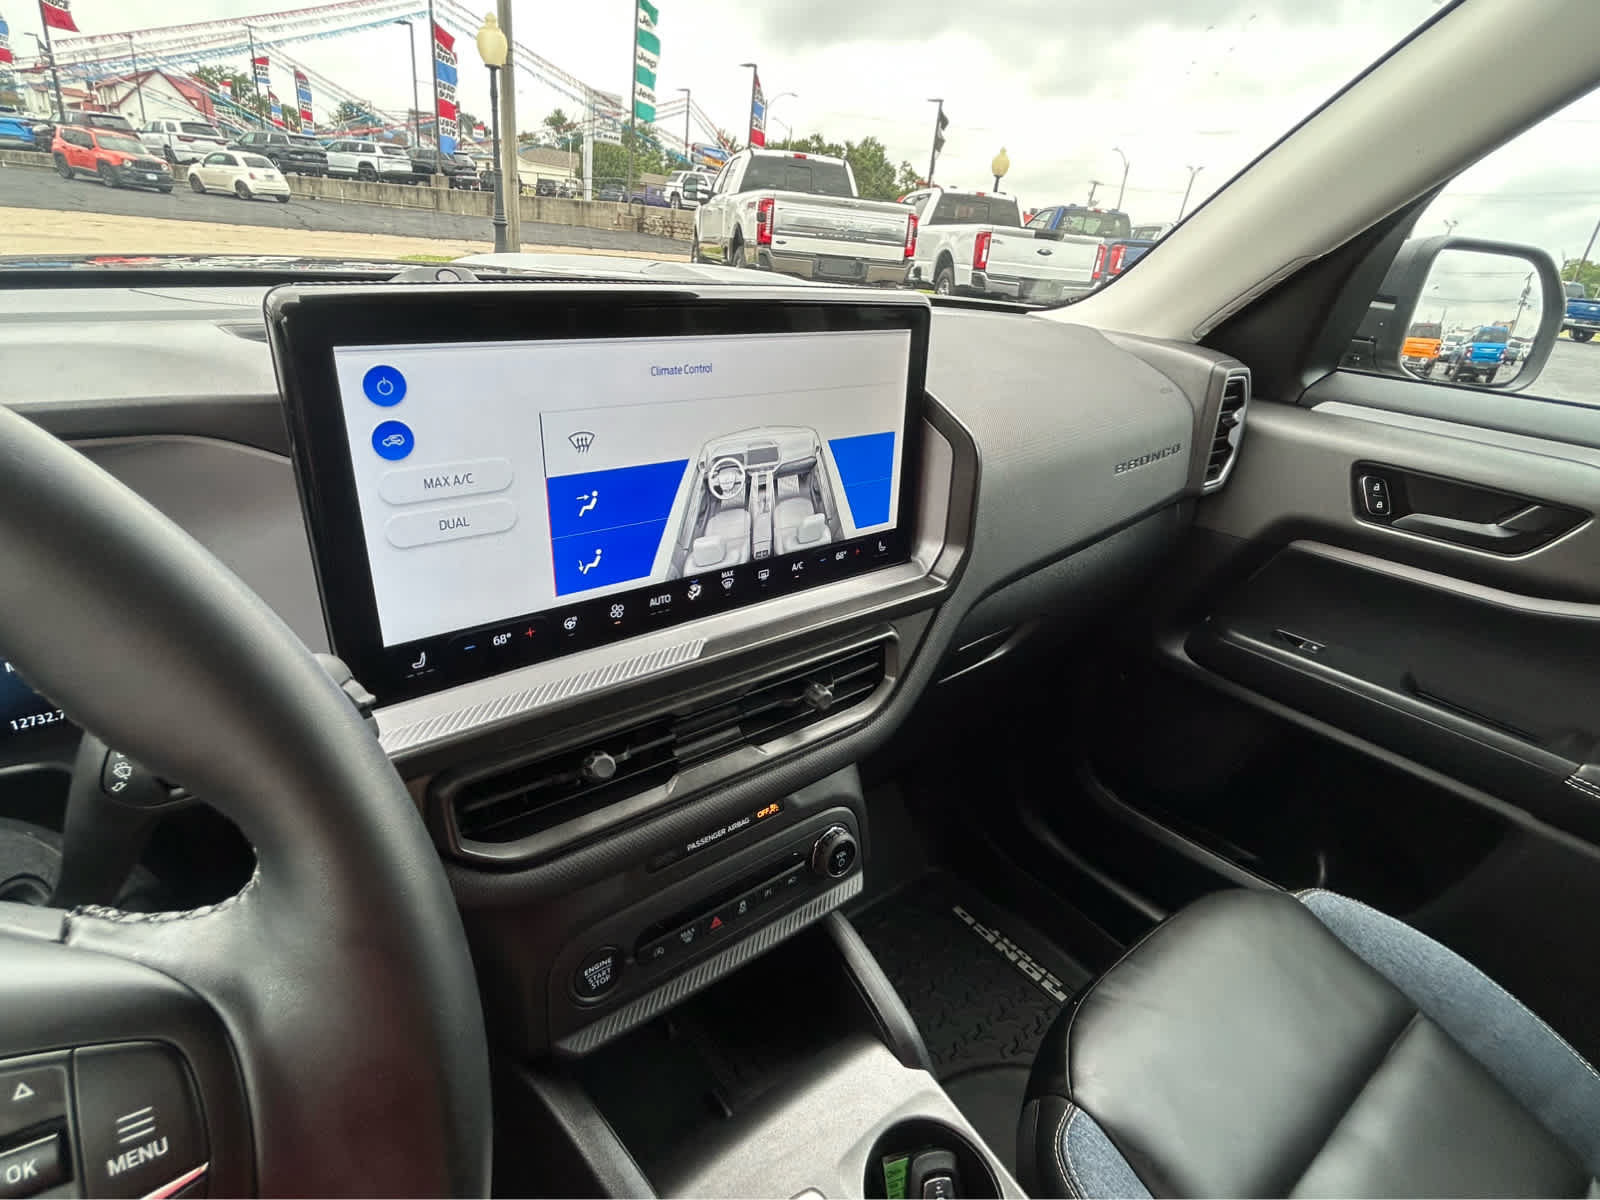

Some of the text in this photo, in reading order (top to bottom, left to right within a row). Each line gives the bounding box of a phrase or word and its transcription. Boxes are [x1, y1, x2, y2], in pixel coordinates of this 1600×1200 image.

[650, 362, 712, 377] Climate Control
[1114, 443, 1181, 474] BRONCO
[424, 472, 474, 489] MAX A/C
[439, 517, 470, 531] DUAL
[791, 561, 804, 572] A/C
[649, 594, 672, 607] AUTO
[9, 709, 65, 731] 12732.7
[757, 808, 770, 818] OFF
[687, 817, 750, 851] PASSENGER AIRBAG
[584, 956, 612, 977] ENGINE
[588, 968, 612, 984] START
[591, 974, 612, 990] STOP
[106, 1136, 169, 1177] MENU
[6, 1158, 38, 1184] OK
